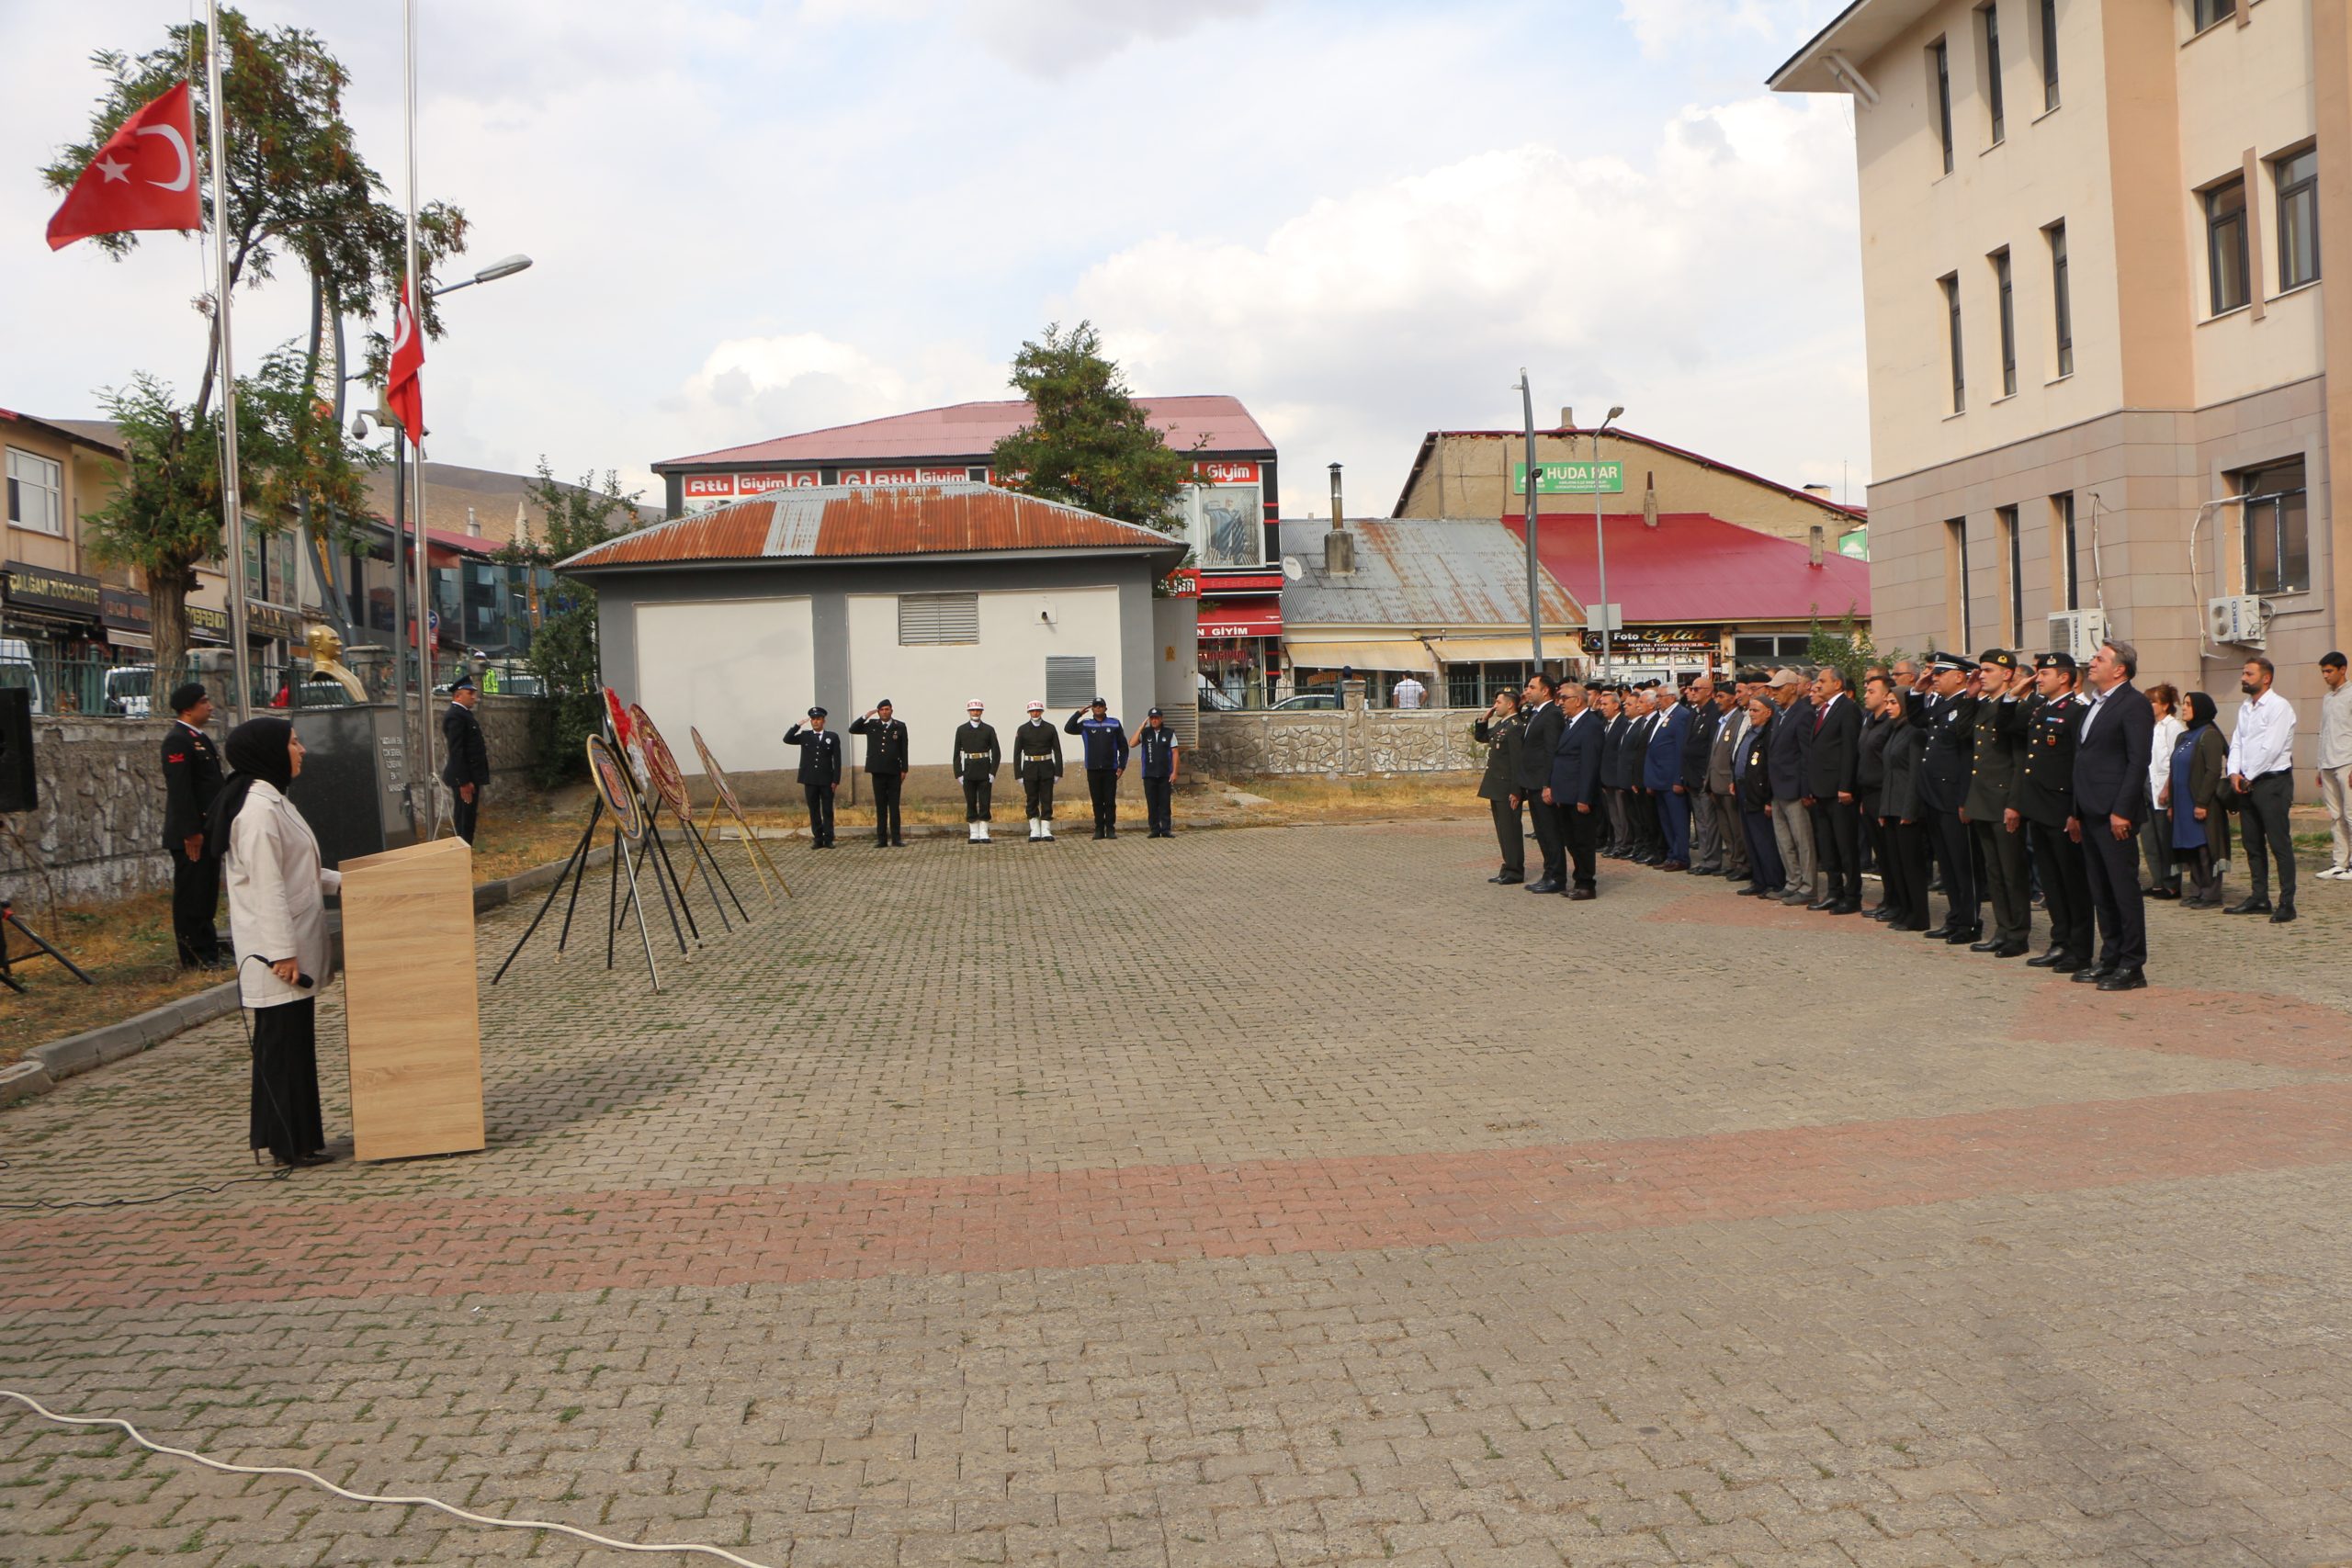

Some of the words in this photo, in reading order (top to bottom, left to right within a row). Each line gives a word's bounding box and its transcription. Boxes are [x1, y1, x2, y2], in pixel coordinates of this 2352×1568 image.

[1206, 464, 1250, 481] Giyim
[1546, 467, 1588, 479] HÜDA
[741, 477, 786, 491] Giyim
[1211, 626, 1249, 636] GİYİM
[1613, 632, 1639, 640] Foto
